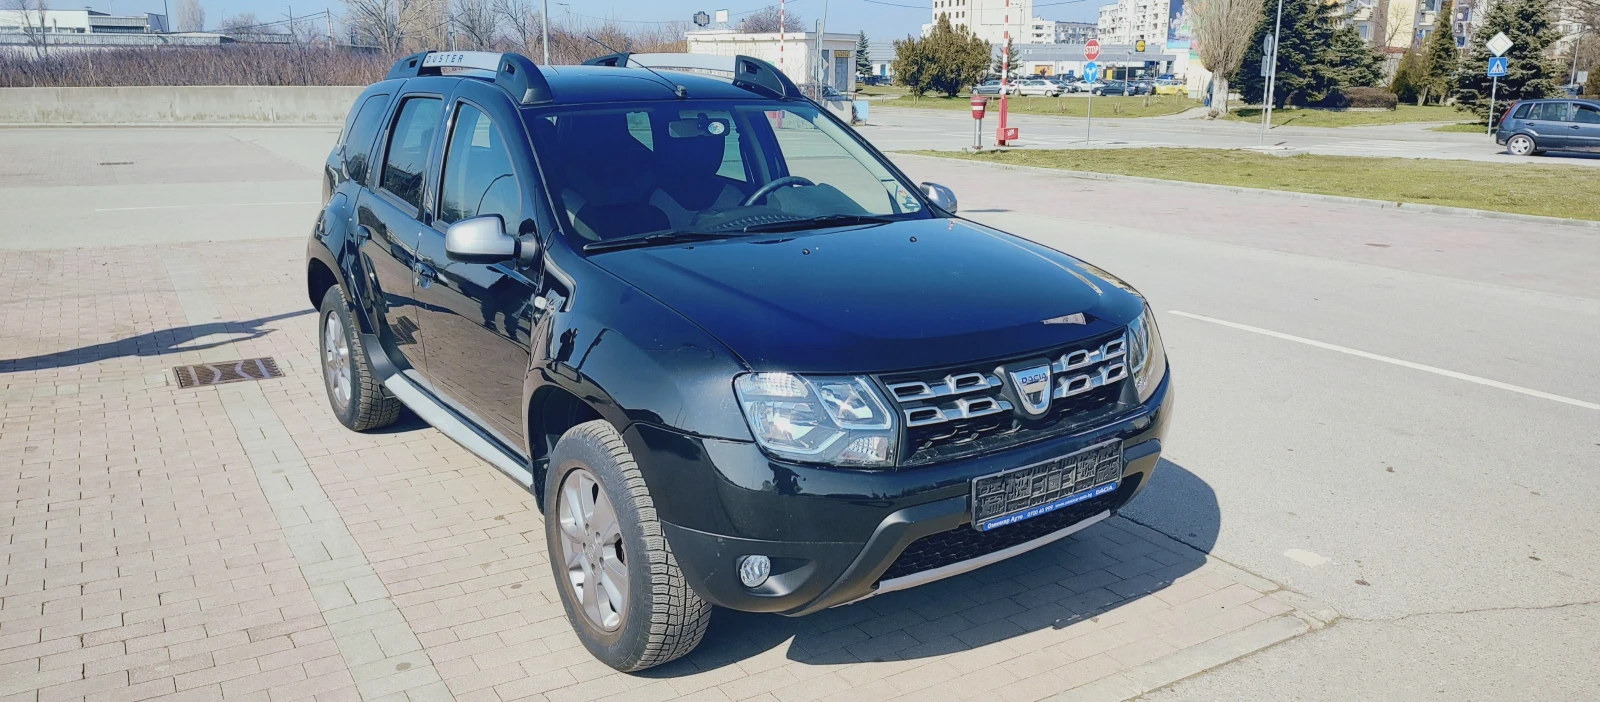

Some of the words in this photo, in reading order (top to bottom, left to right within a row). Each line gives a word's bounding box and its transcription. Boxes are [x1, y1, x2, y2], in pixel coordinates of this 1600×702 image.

[1085, 45, 1099, 55] STOP
[426, 54, 464, 64] DUSTER
[1021, 372, 1047, 384] DACIA
[1096, 485, 1113, 495] DACIA
